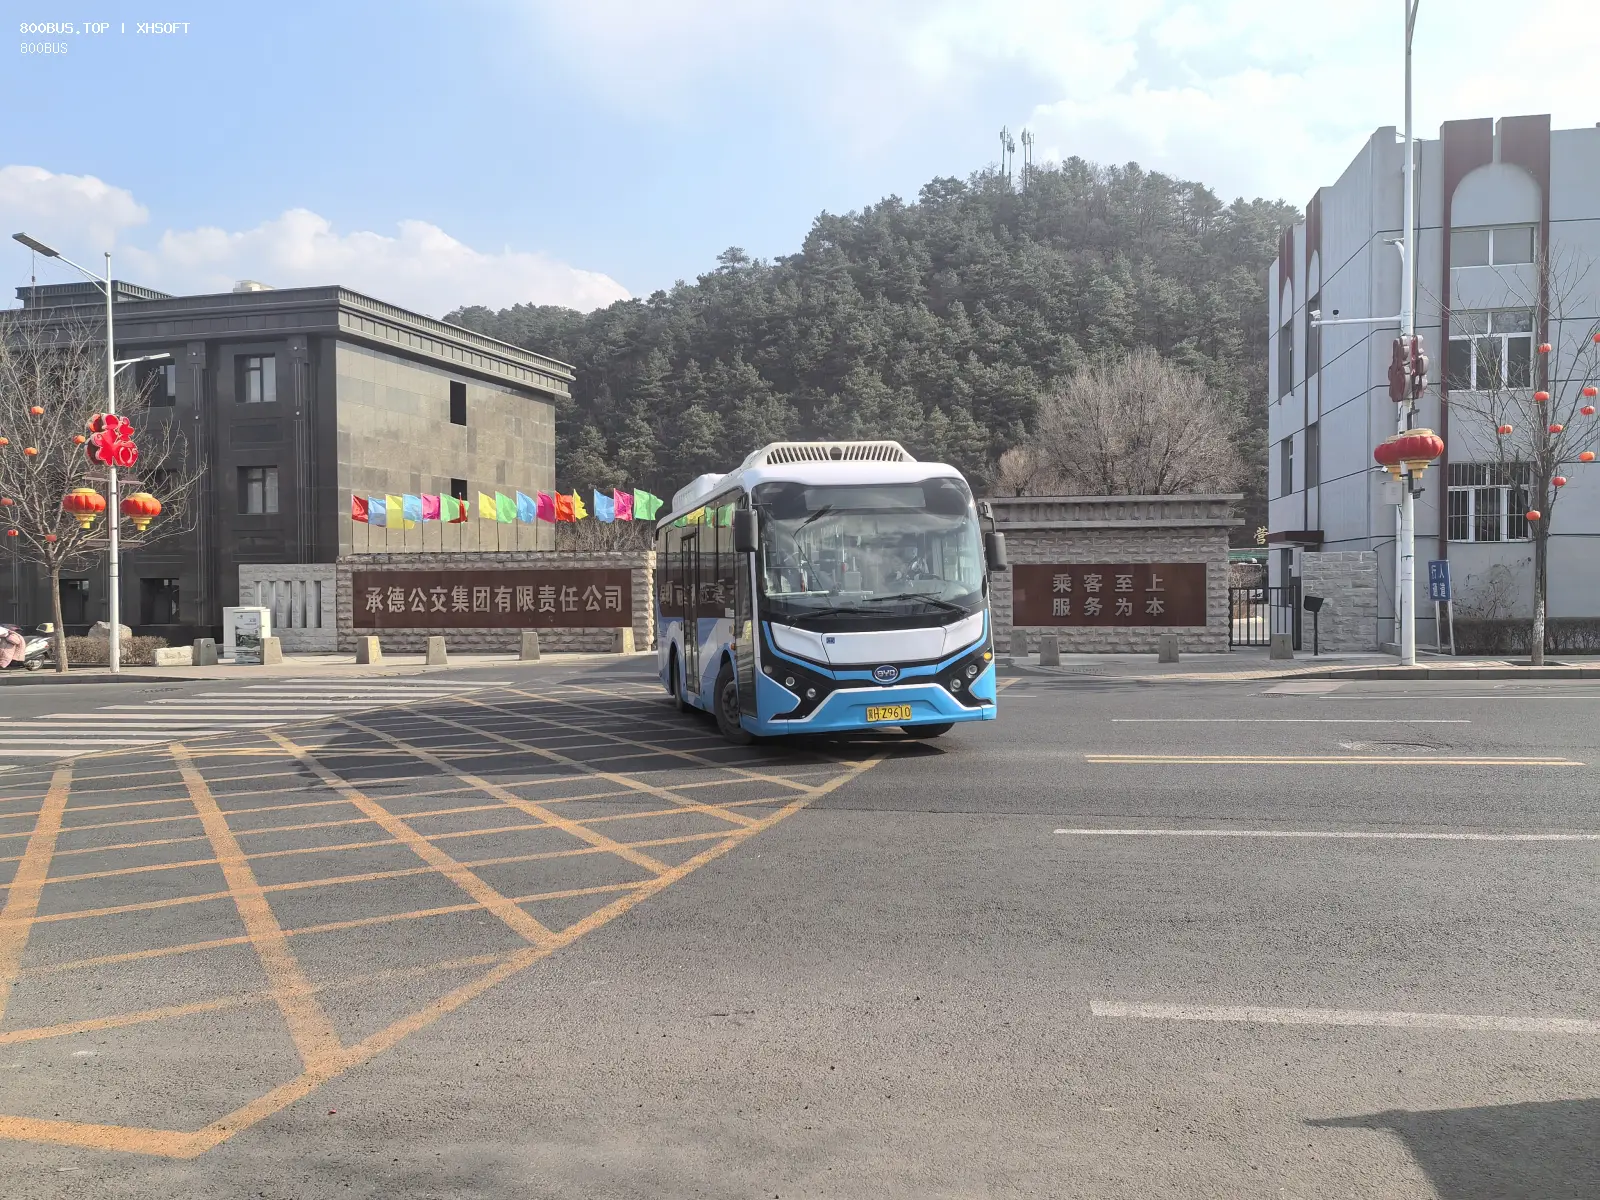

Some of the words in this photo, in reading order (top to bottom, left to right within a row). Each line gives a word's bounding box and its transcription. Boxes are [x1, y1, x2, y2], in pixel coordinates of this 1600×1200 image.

[1052, 573, 1165, 593] 乘客至上
[365, 584, 623, 613] 承德公交集团有限责任公司
[1052, 597, 1165, 617] 服务为本
[877, 669, 896, 677] BYD
